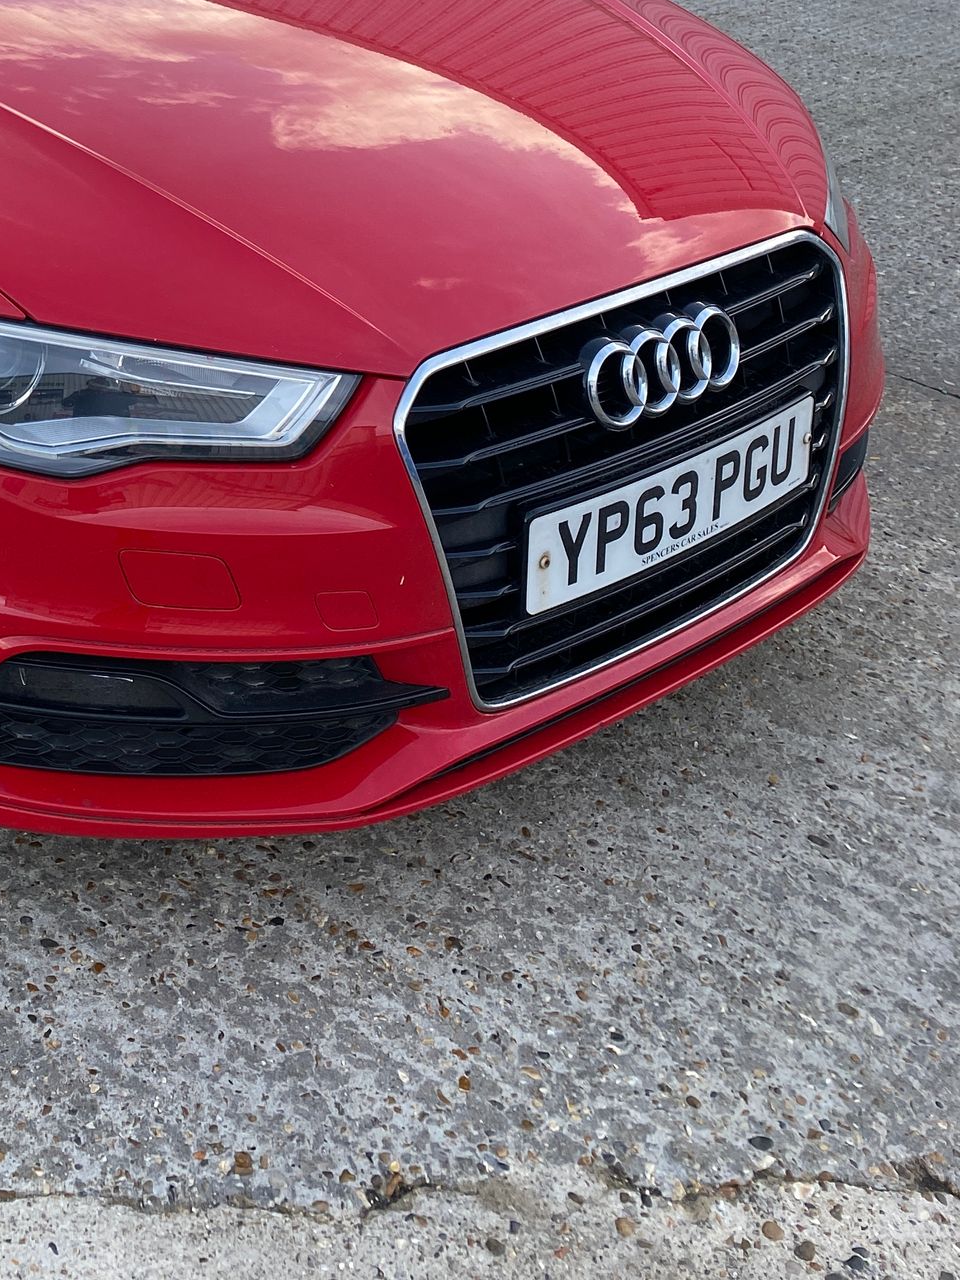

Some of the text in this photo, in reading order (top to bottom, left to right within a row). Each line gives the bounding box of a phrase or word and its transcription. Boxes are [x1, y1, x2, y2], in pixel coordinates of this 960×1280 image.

[558, 417, 796, 586] YP63 PGU
[641, 522, 719, 566] SPENCERS CAR SALES
